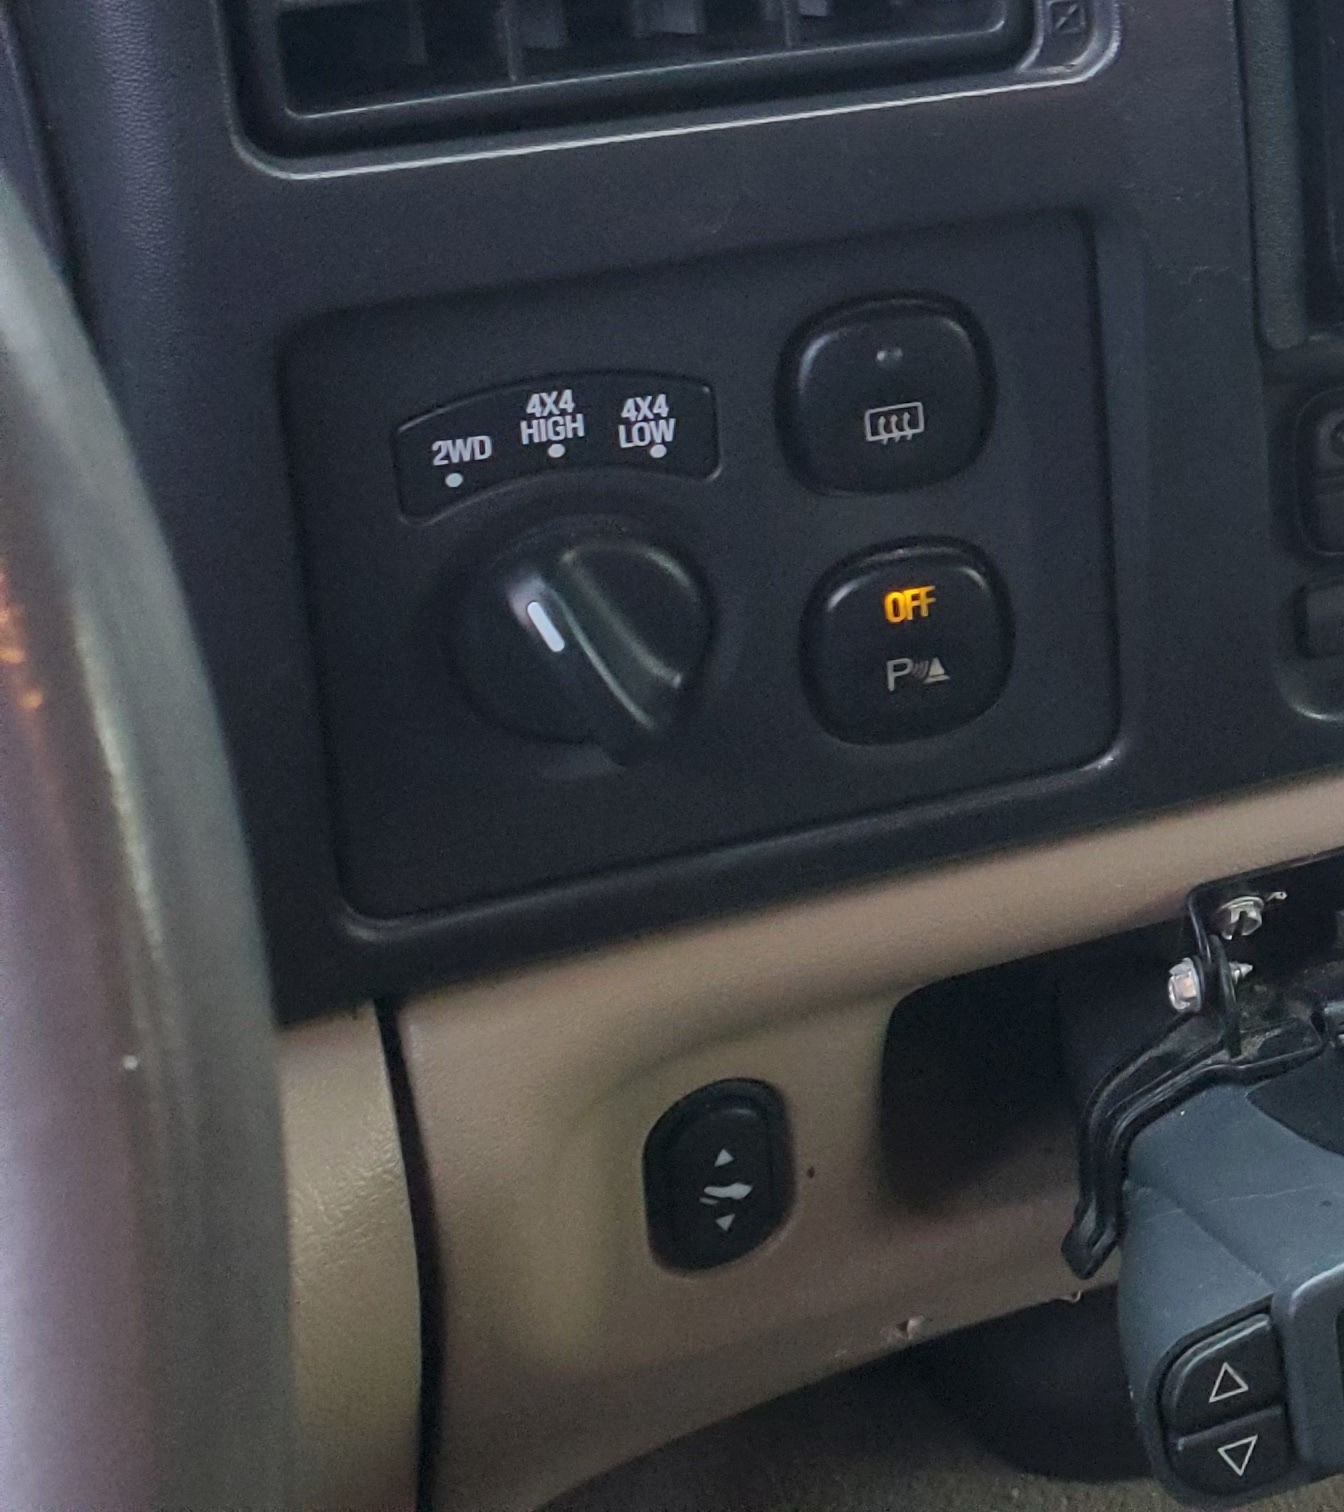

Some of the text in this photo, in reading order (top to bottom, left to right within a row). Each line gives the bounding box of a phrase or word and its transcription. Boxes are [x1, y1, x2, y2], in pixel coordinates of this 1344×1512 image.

[519, 413, 585, 445] HIGH
[618, 418, 676, 448] LOW
[431, 434, 492, 466] 2WD
[883, 585, 936, 624] OFF
[887, 657, 911, 692] P
